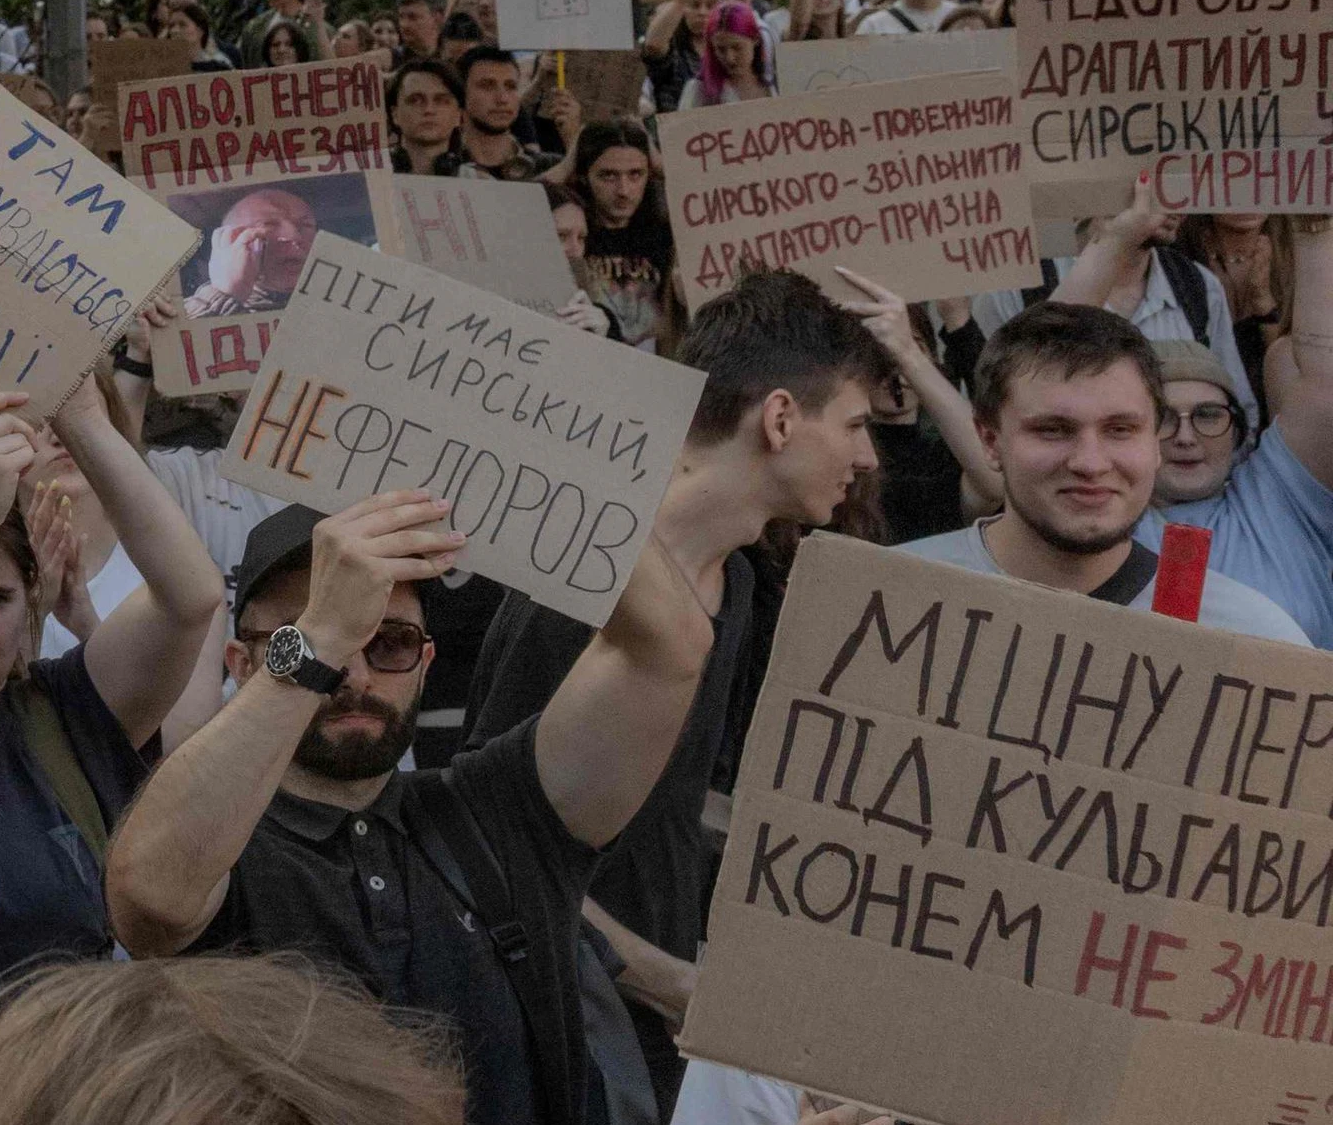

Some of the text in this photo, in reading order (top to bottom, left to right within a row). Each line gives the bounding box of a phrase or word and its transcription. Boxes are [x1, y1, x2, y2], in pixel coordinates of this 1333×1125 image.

[8, 120, 127, 235] ТАМ
[140, 121, 386, 190] ПАРМЕЗАН
[1032, 89, 1280, 164] СИРСЬКИЙ
[941, 226, 1036, 273] ЧИТИ
[298, 257, 552, 366] ПІТИ МАЄ
[818, 589, 1333, 810] МІЦНУ ПЕР
[773, 697, 1333, 929] ПІД КУЛЬГАВИ
[744, 821, 1333, 1046] КОНЕМ НЕ ЗМІН
